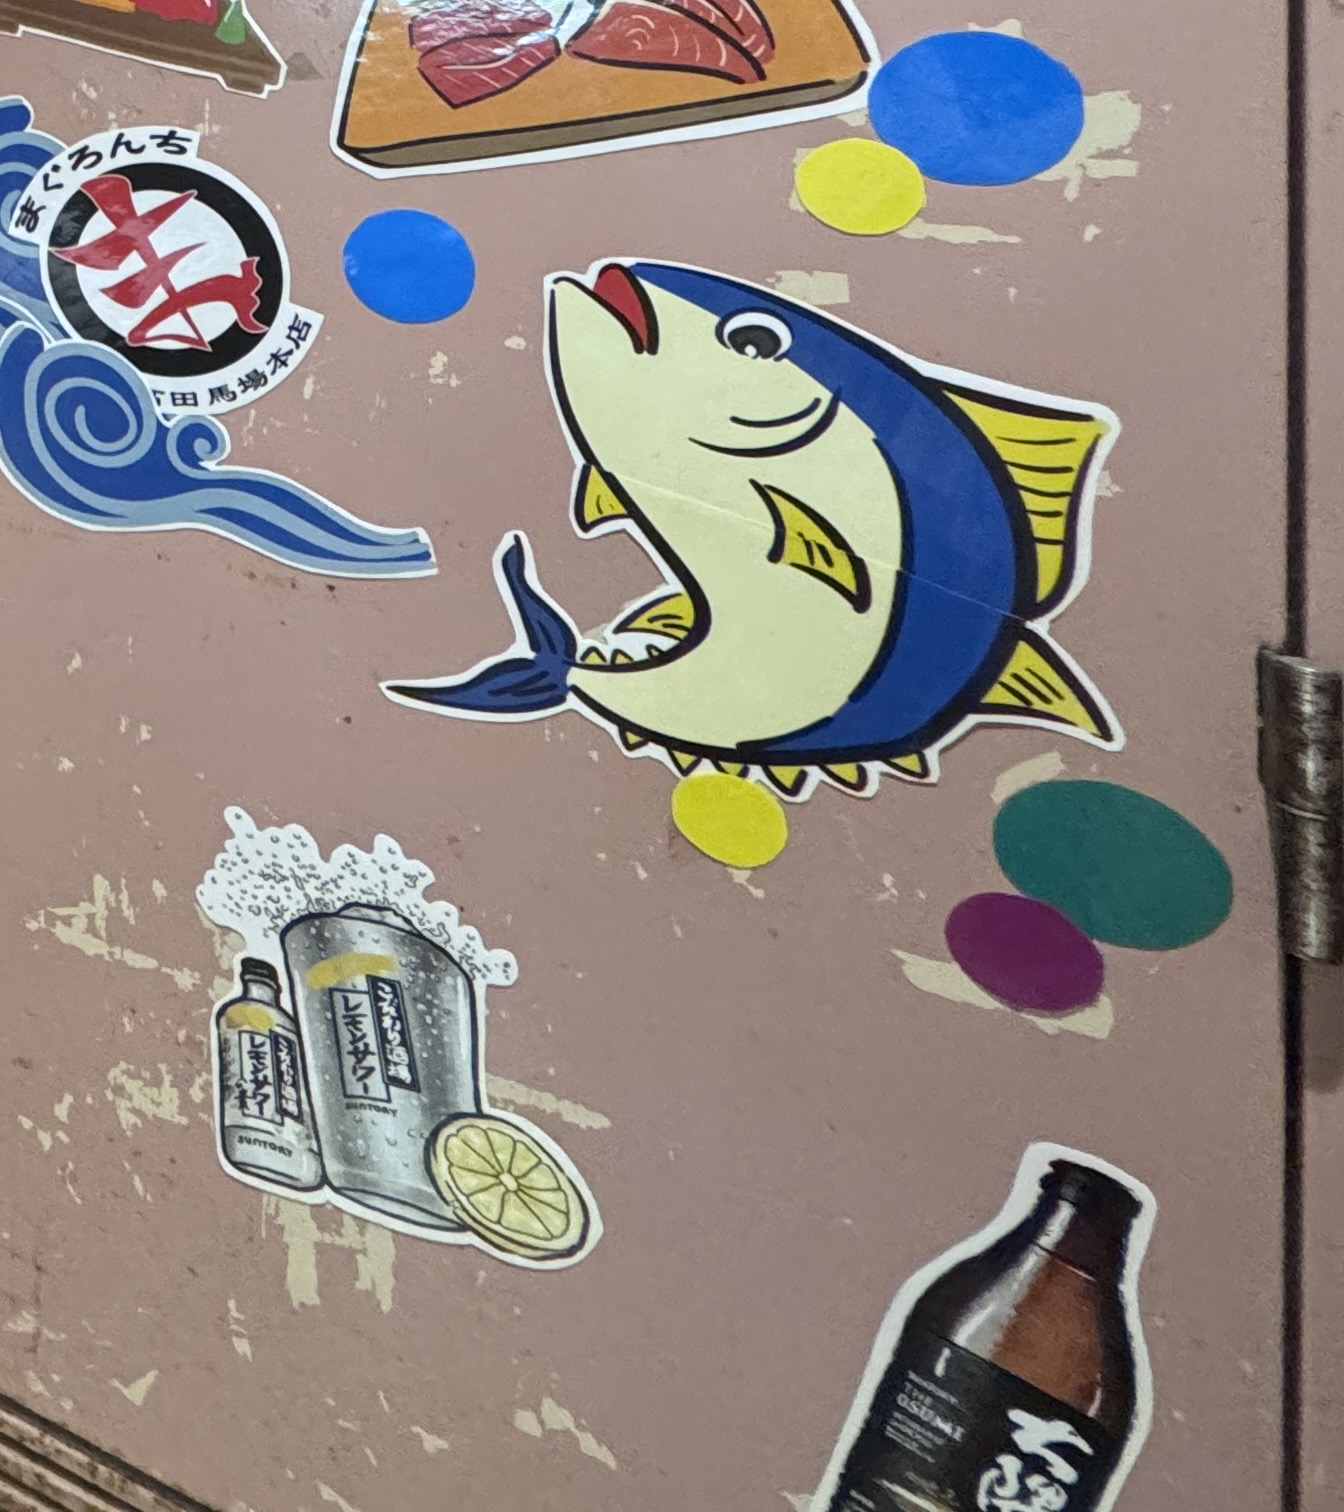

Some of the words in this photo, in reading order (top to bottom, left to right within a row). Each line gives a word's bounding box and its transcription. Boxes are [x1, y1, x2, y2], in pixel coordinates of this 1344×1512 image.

[15, 130, 194, 233] まぐろんち
[341, 994, 376, 1095] レモンサワー
